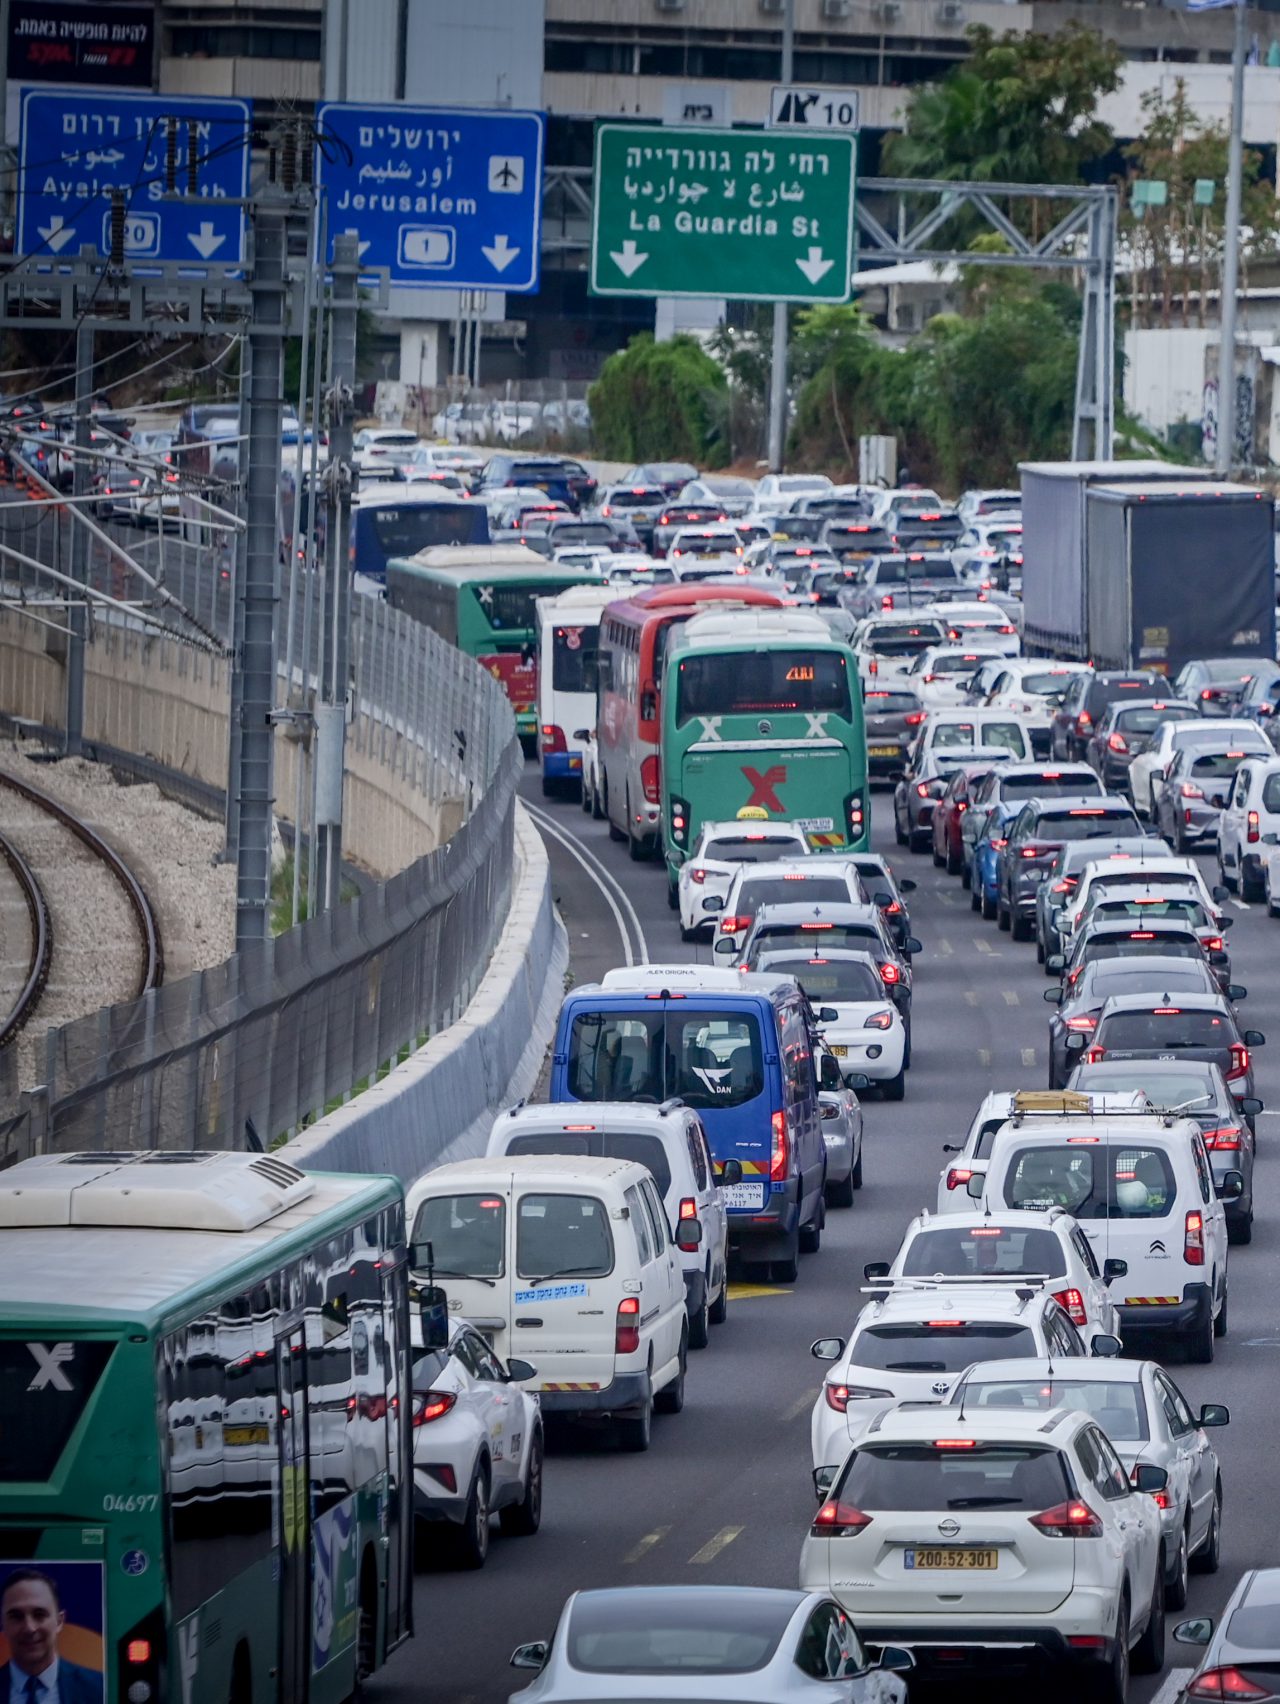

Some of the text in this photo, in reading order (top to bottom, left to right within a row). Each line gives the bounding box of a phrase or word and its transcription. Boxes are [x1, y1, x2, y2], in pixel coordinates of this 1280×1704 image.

[683, 103, 714, 121] בית
[823, 102, 853, 125] 10
[62, 113, 121, 136] דרום
[358, 124, 461, 151] ירושלים
[626, 146, 731, 172] גוורדייה
[744, 149, 776, 174] לה
[358, 155, 453, 189] أورشليم
[722, 178, 736, 199] لا
[748, 180, 805, 208] شارع
[336, 189, 478, 215] Jerusalem
[629, 209, 820, 238] La Guardia St
[422, 238, 431, 254] 1
[716, 1086, 732, 1094] DAN
[103, 1494, 159, 1512] 04697
